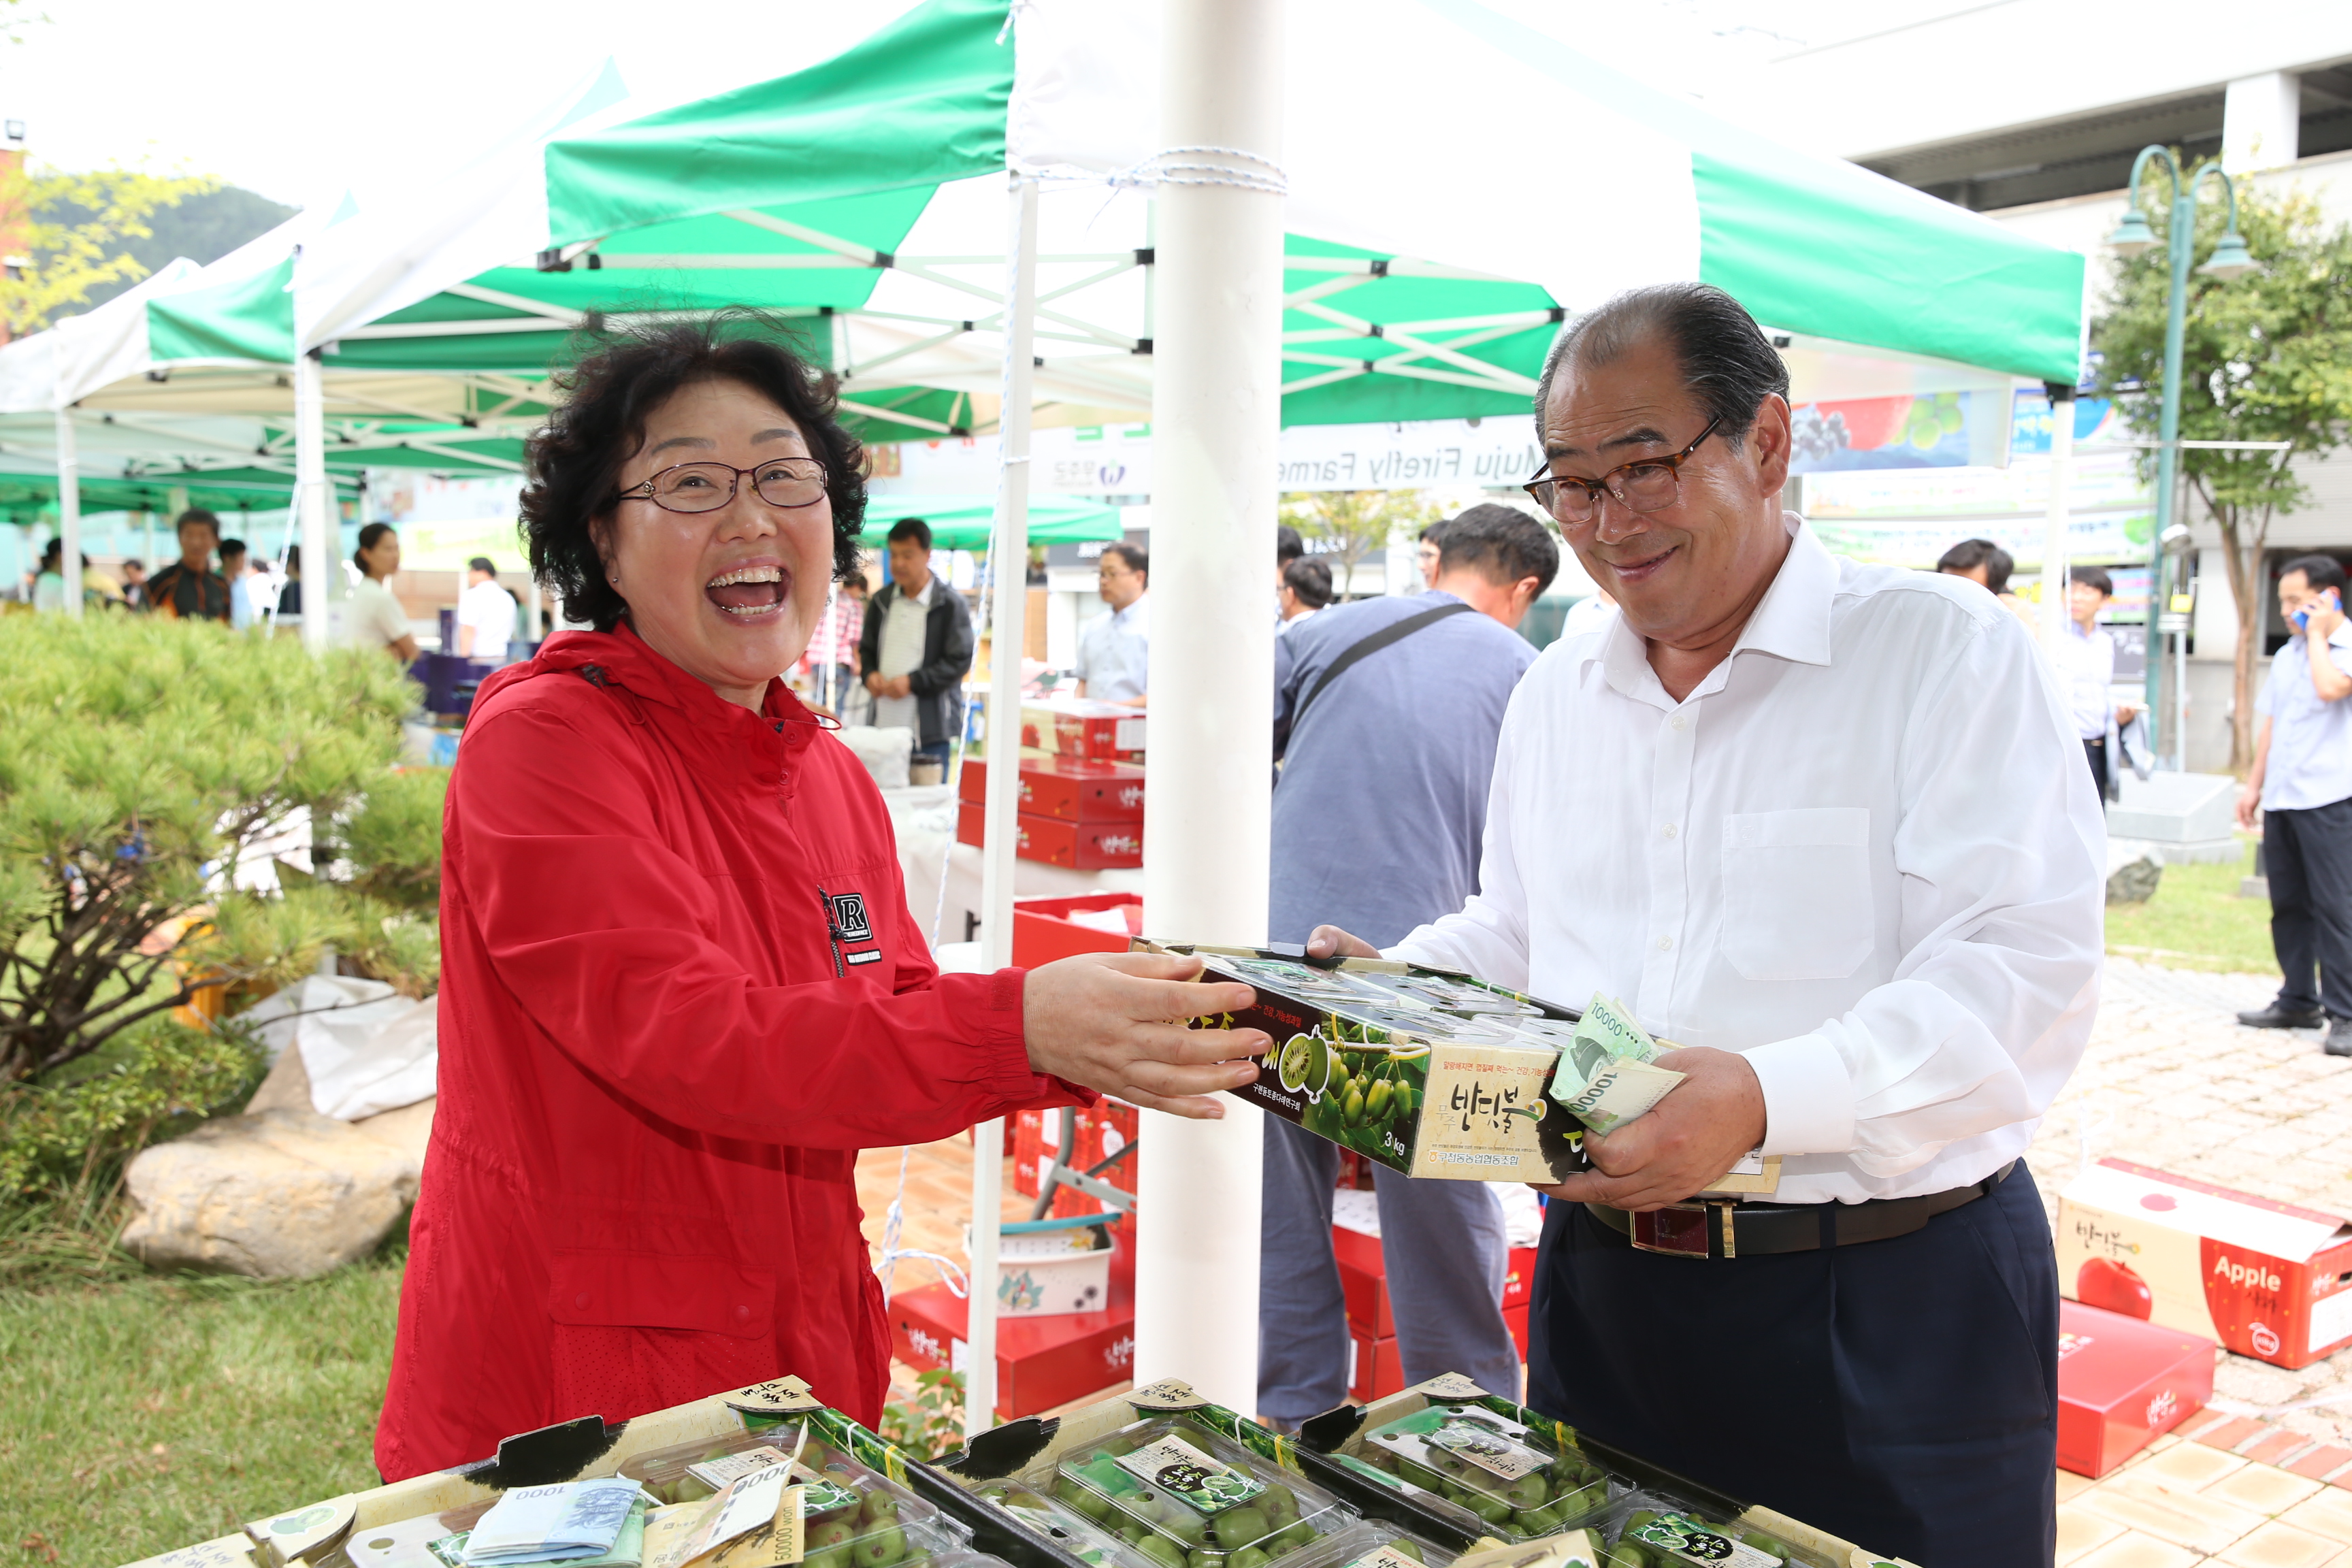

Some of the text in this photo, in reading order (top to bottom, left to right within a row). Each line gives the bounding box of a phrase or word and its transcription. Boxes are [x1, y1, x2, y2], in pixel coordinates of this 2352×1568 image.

[841, 899, 864, 931] R
[1591, 1002, 1622, 1037] 10000
[1443, 1062, 1473, 1071] 말랑해지면
[1451, 1081, 1524, 1134] 반딧불
[1569, 1072, 1618, 1112] 10000
[1438, 1152, 1519, 1166] 구천동농업협동조합
[2214, 1256, 2281, 1292] Apple
[515, 1486, 566, 1500] 1000
[774, 1505, 793, 1561] 50000 won
